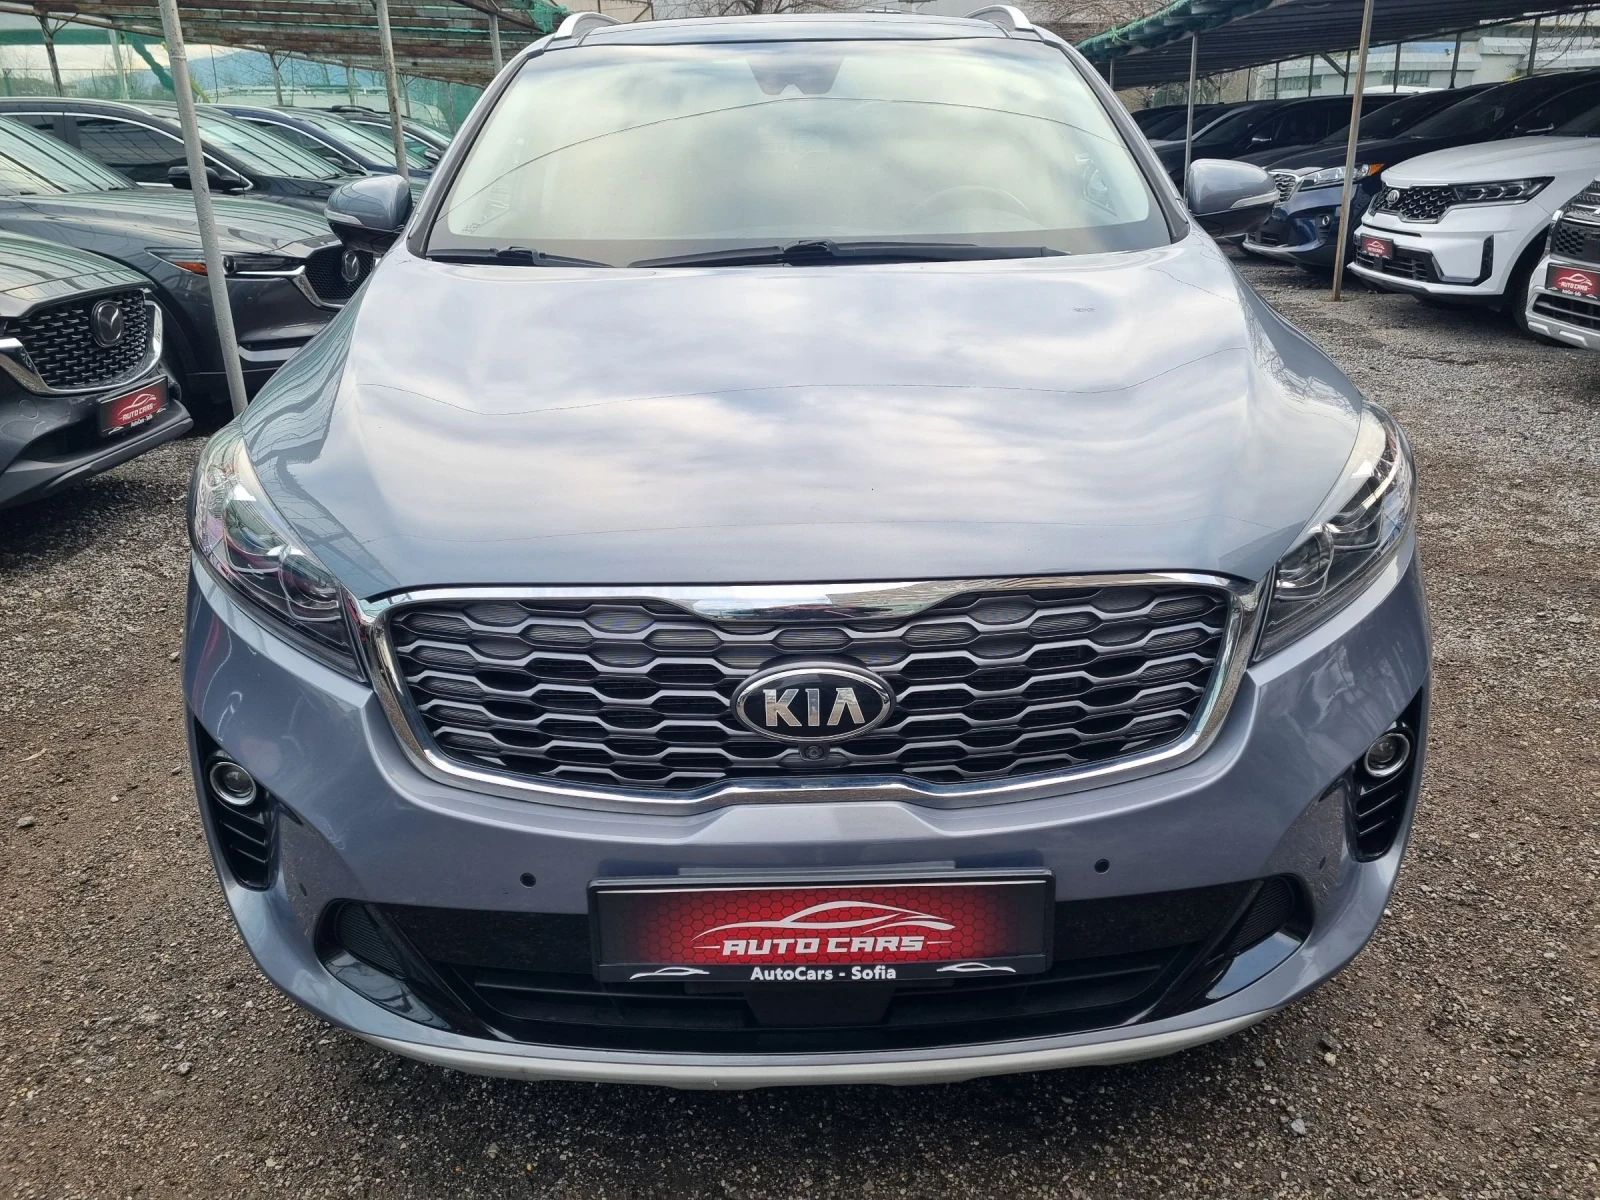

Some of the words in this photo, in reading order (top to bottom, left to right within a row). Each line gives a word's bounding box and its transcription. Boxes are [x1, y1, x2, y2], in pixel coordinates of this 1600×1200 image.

[762, 687, 866, 727] KIA
[722, 937, 821, 956] AUTO
[826, 935, 925, 953] CARS
[750, 966, 834, 981] AutoCars
[851, 965, 897, 980] Sofia
